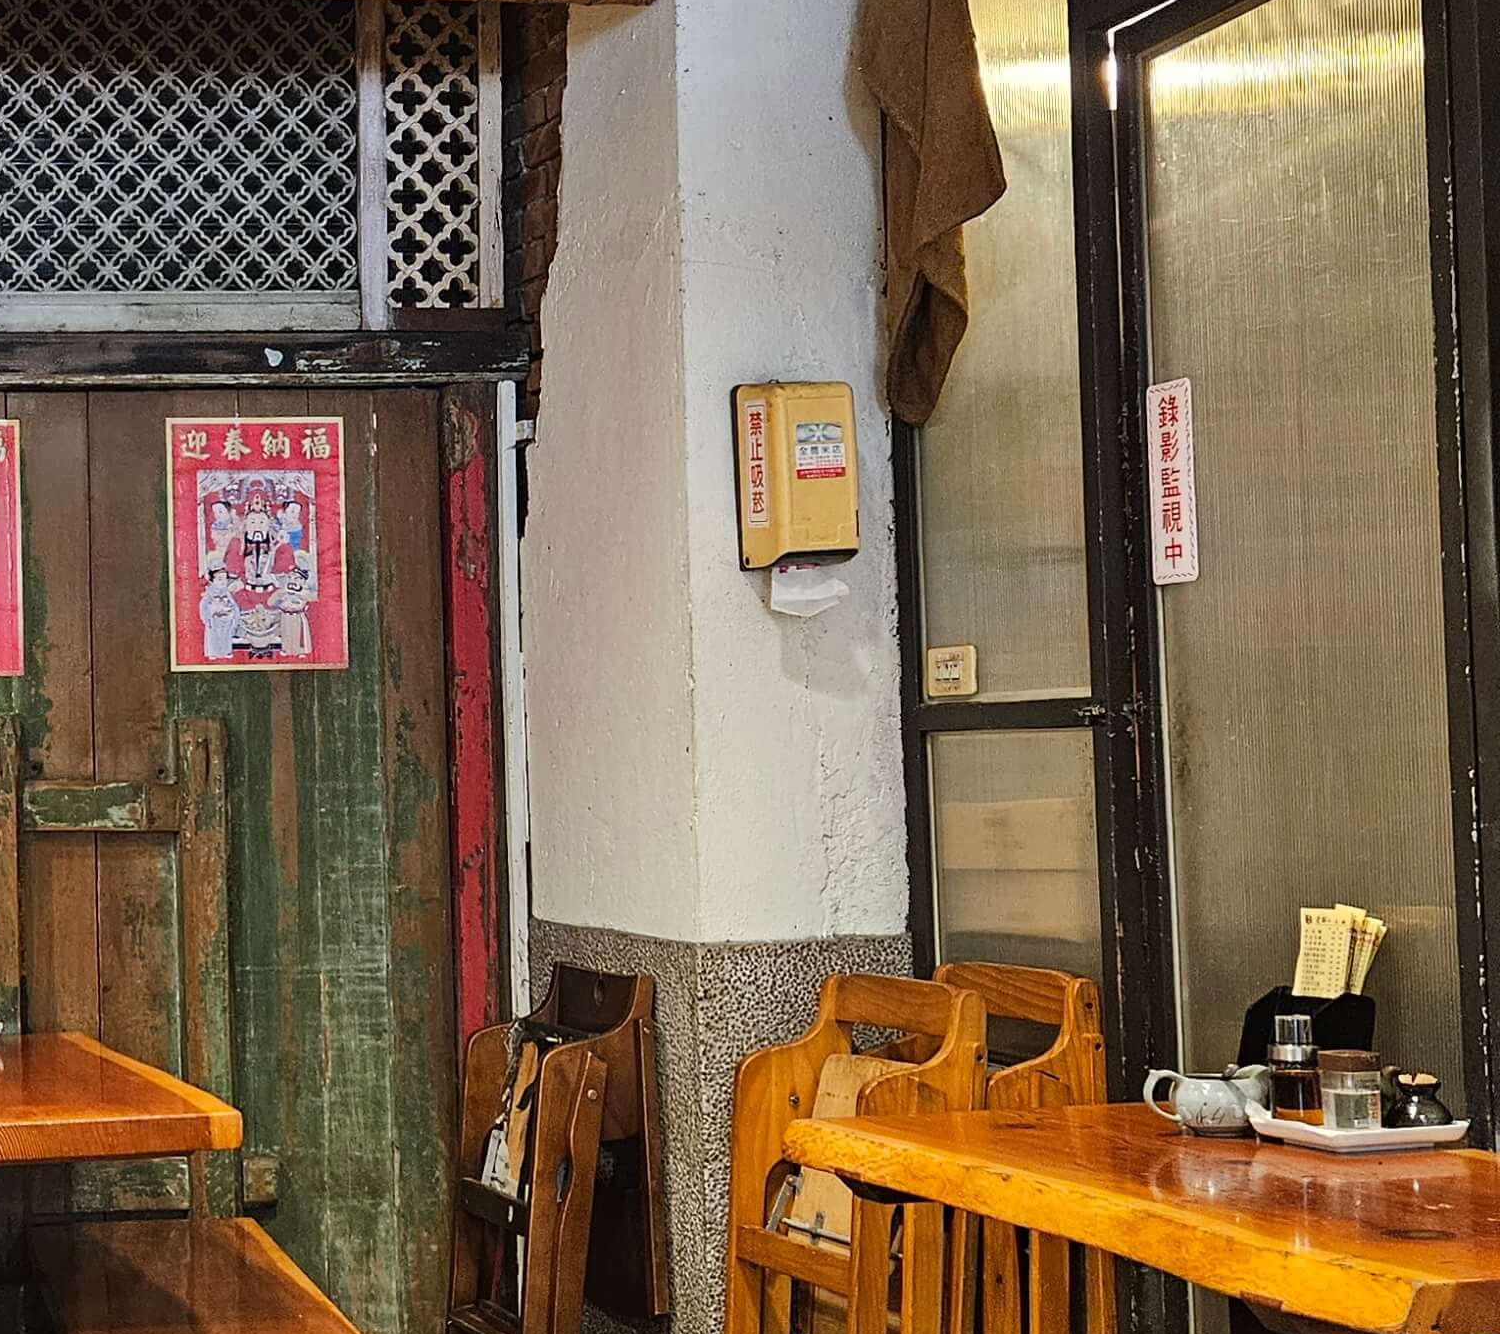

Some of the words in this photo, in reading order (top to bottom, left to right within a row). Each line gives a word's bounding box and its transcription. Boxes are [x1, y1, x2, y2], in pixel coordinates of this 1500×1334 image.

[179, 427, 331, 461] 迎春納福
[749, 411, 765, 514] 禁止吸菸
[1158, 394, 1183, 570] 錄影監視中
